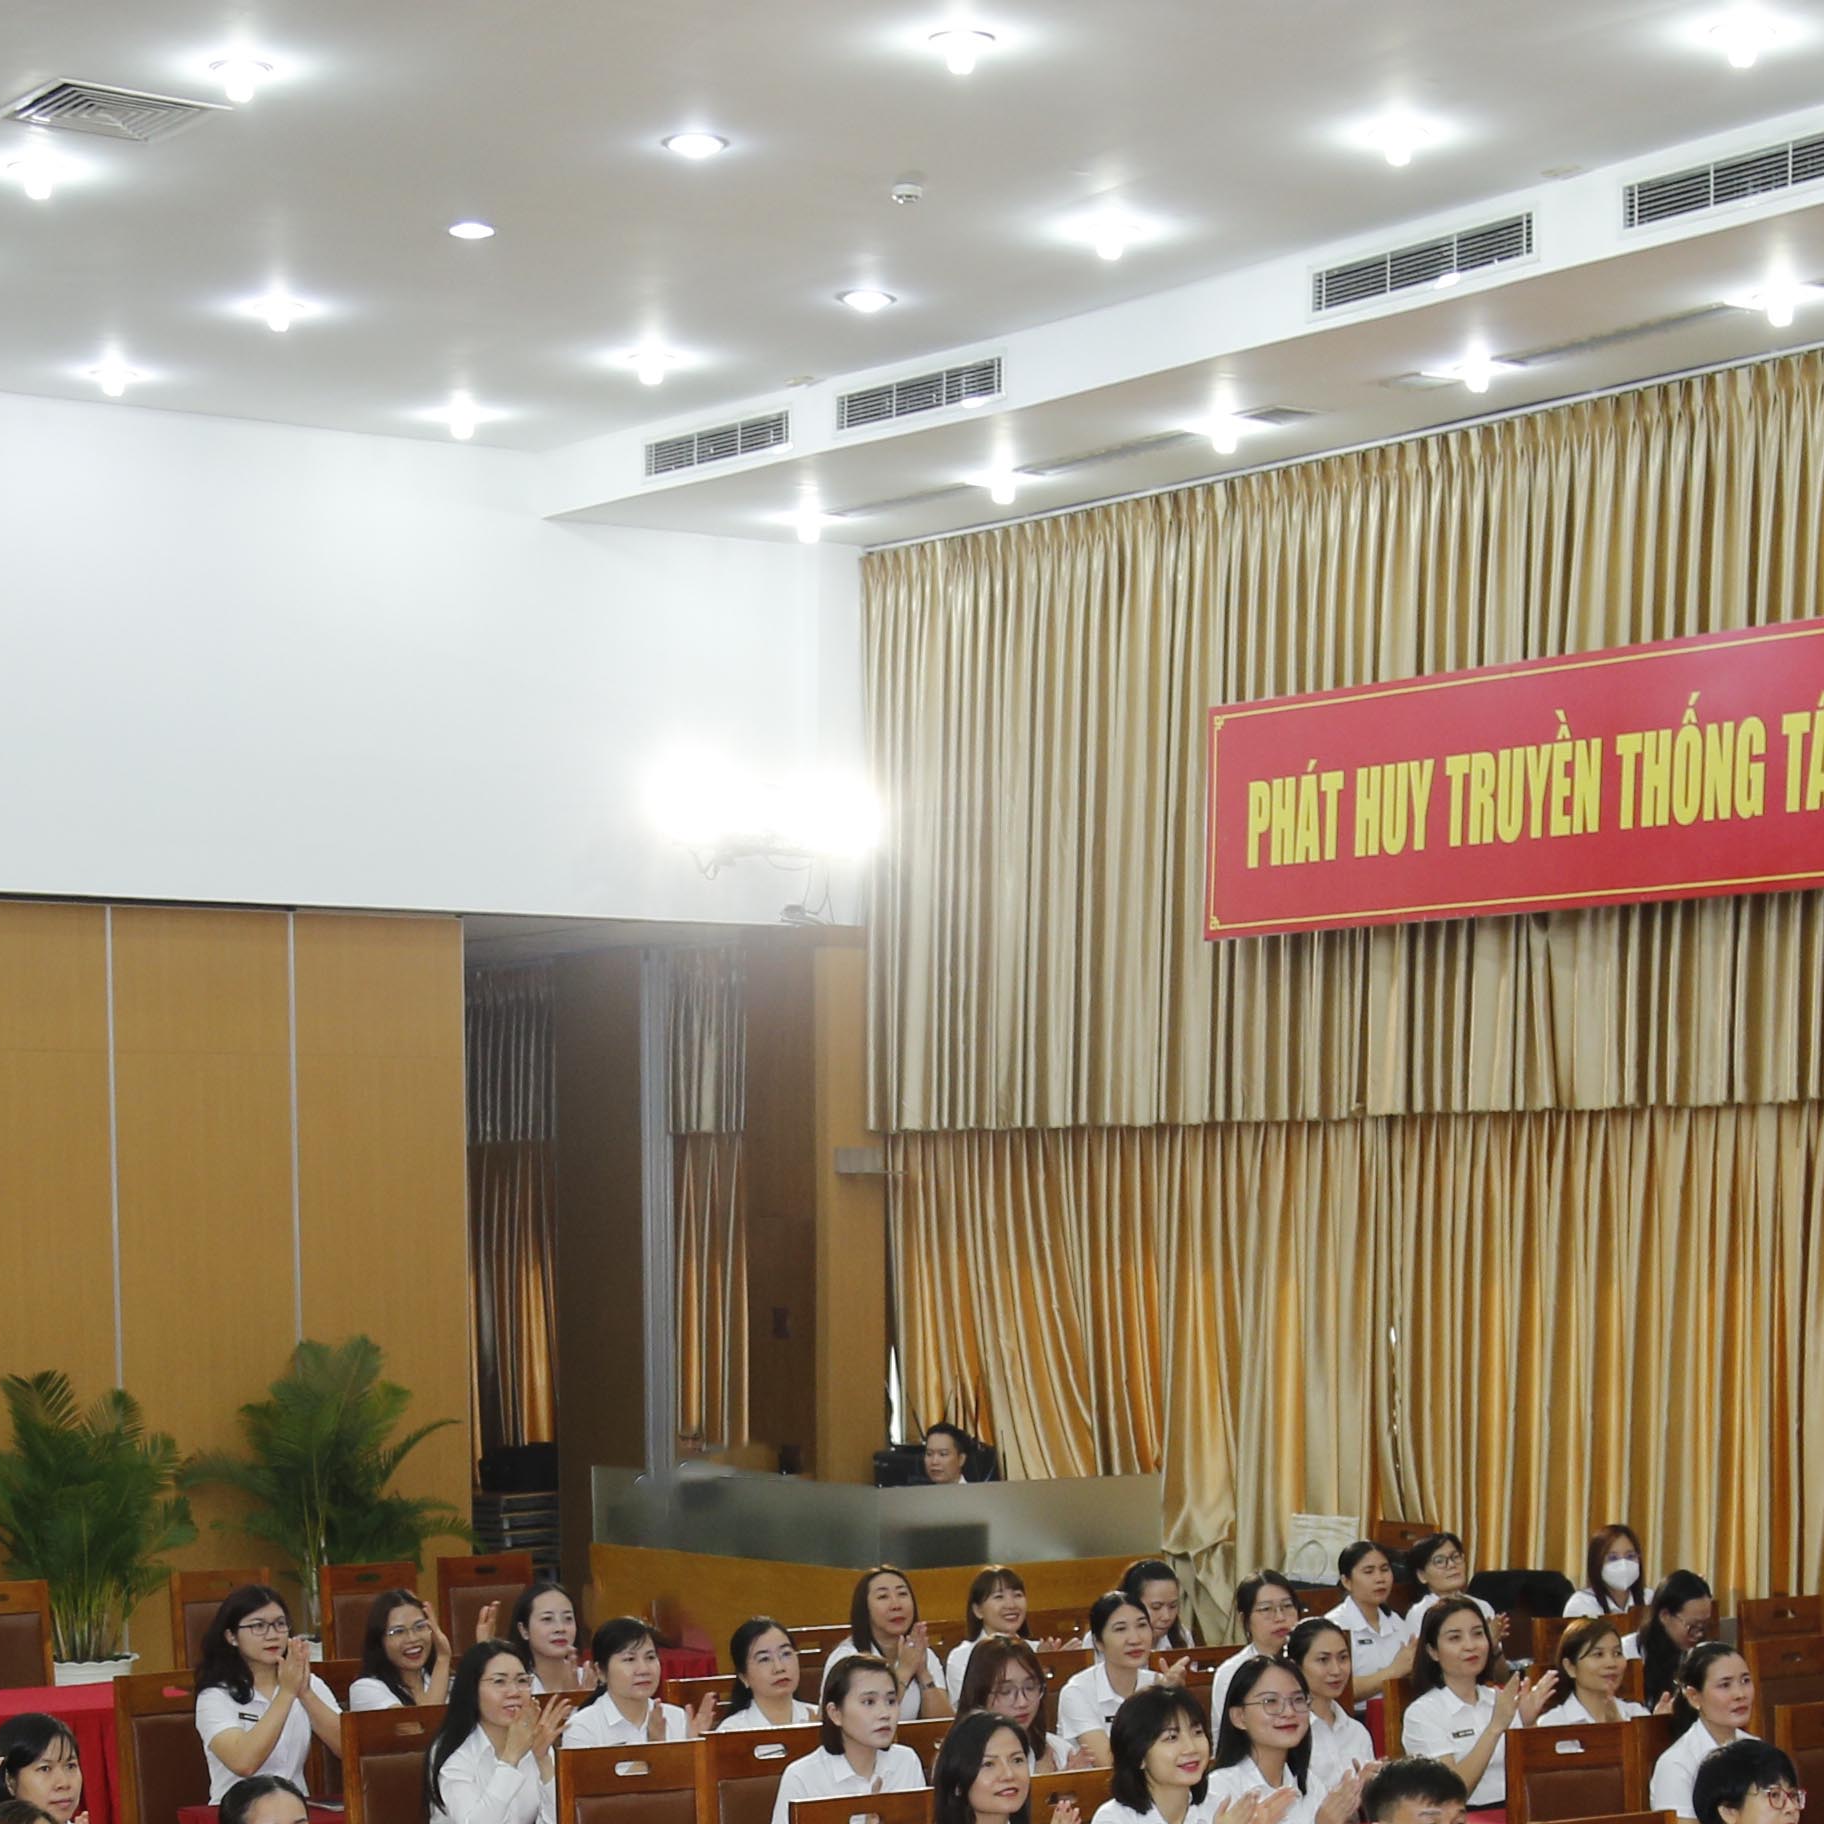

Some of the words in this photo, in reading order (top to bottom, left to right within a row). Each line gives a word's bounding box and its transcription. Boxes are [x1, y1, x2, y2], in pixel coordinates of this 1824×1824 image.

[1247, 755, 1344, 868] PHÁT
[1354, 760, 1434, 857] HUY
[1445, 710, 1602, 847] TRUYỀN
[1616, 693, 1766, 829] THỐNG
